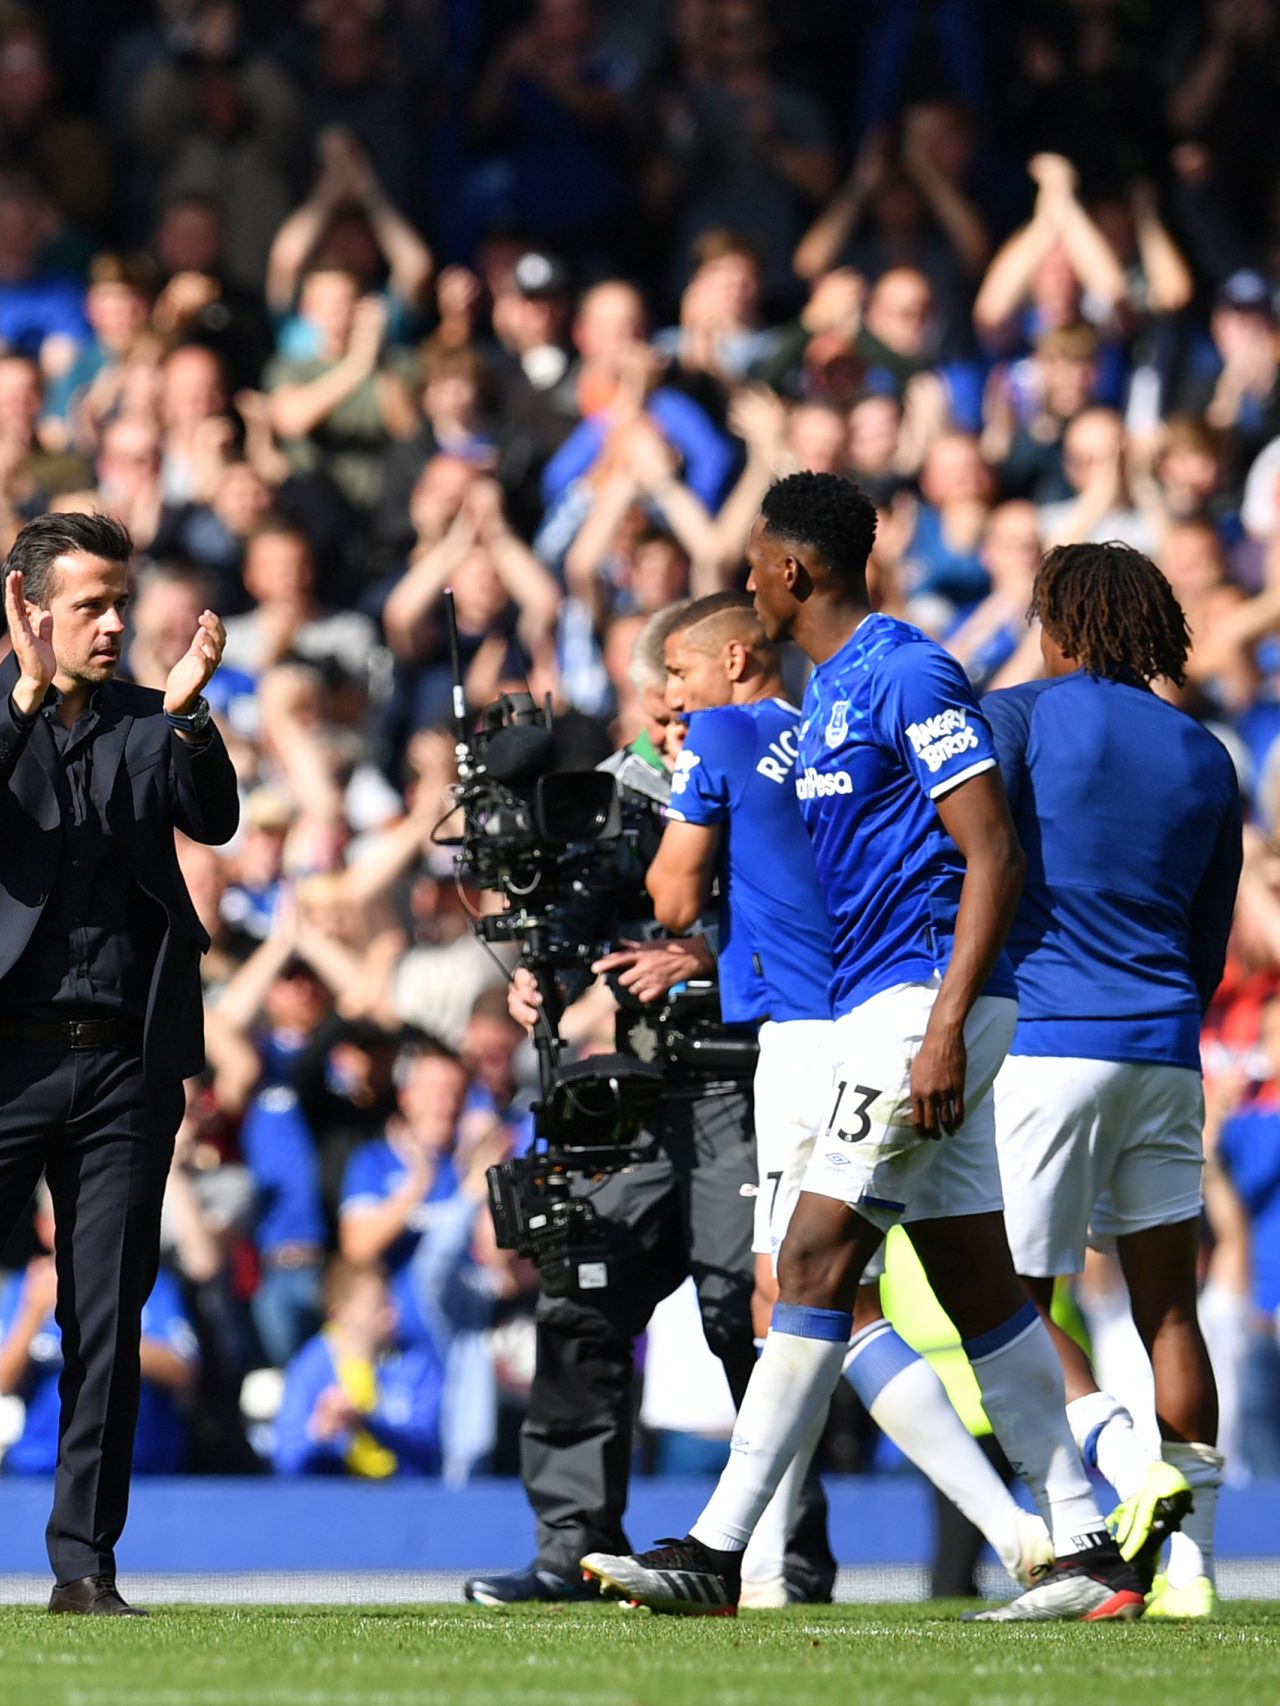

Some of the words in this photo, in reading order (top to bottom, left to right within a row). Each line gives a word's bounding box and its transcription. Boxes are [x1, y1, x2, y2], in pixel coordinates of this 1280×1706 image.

[756, 725, 800, 784] RIC
[905, 708, 966, 754] ANGRY
[917, 726, 979, 773] BIRDS
[825, 1081, 882, 1143] 13
[766, 1170, 784, 1228] 7
